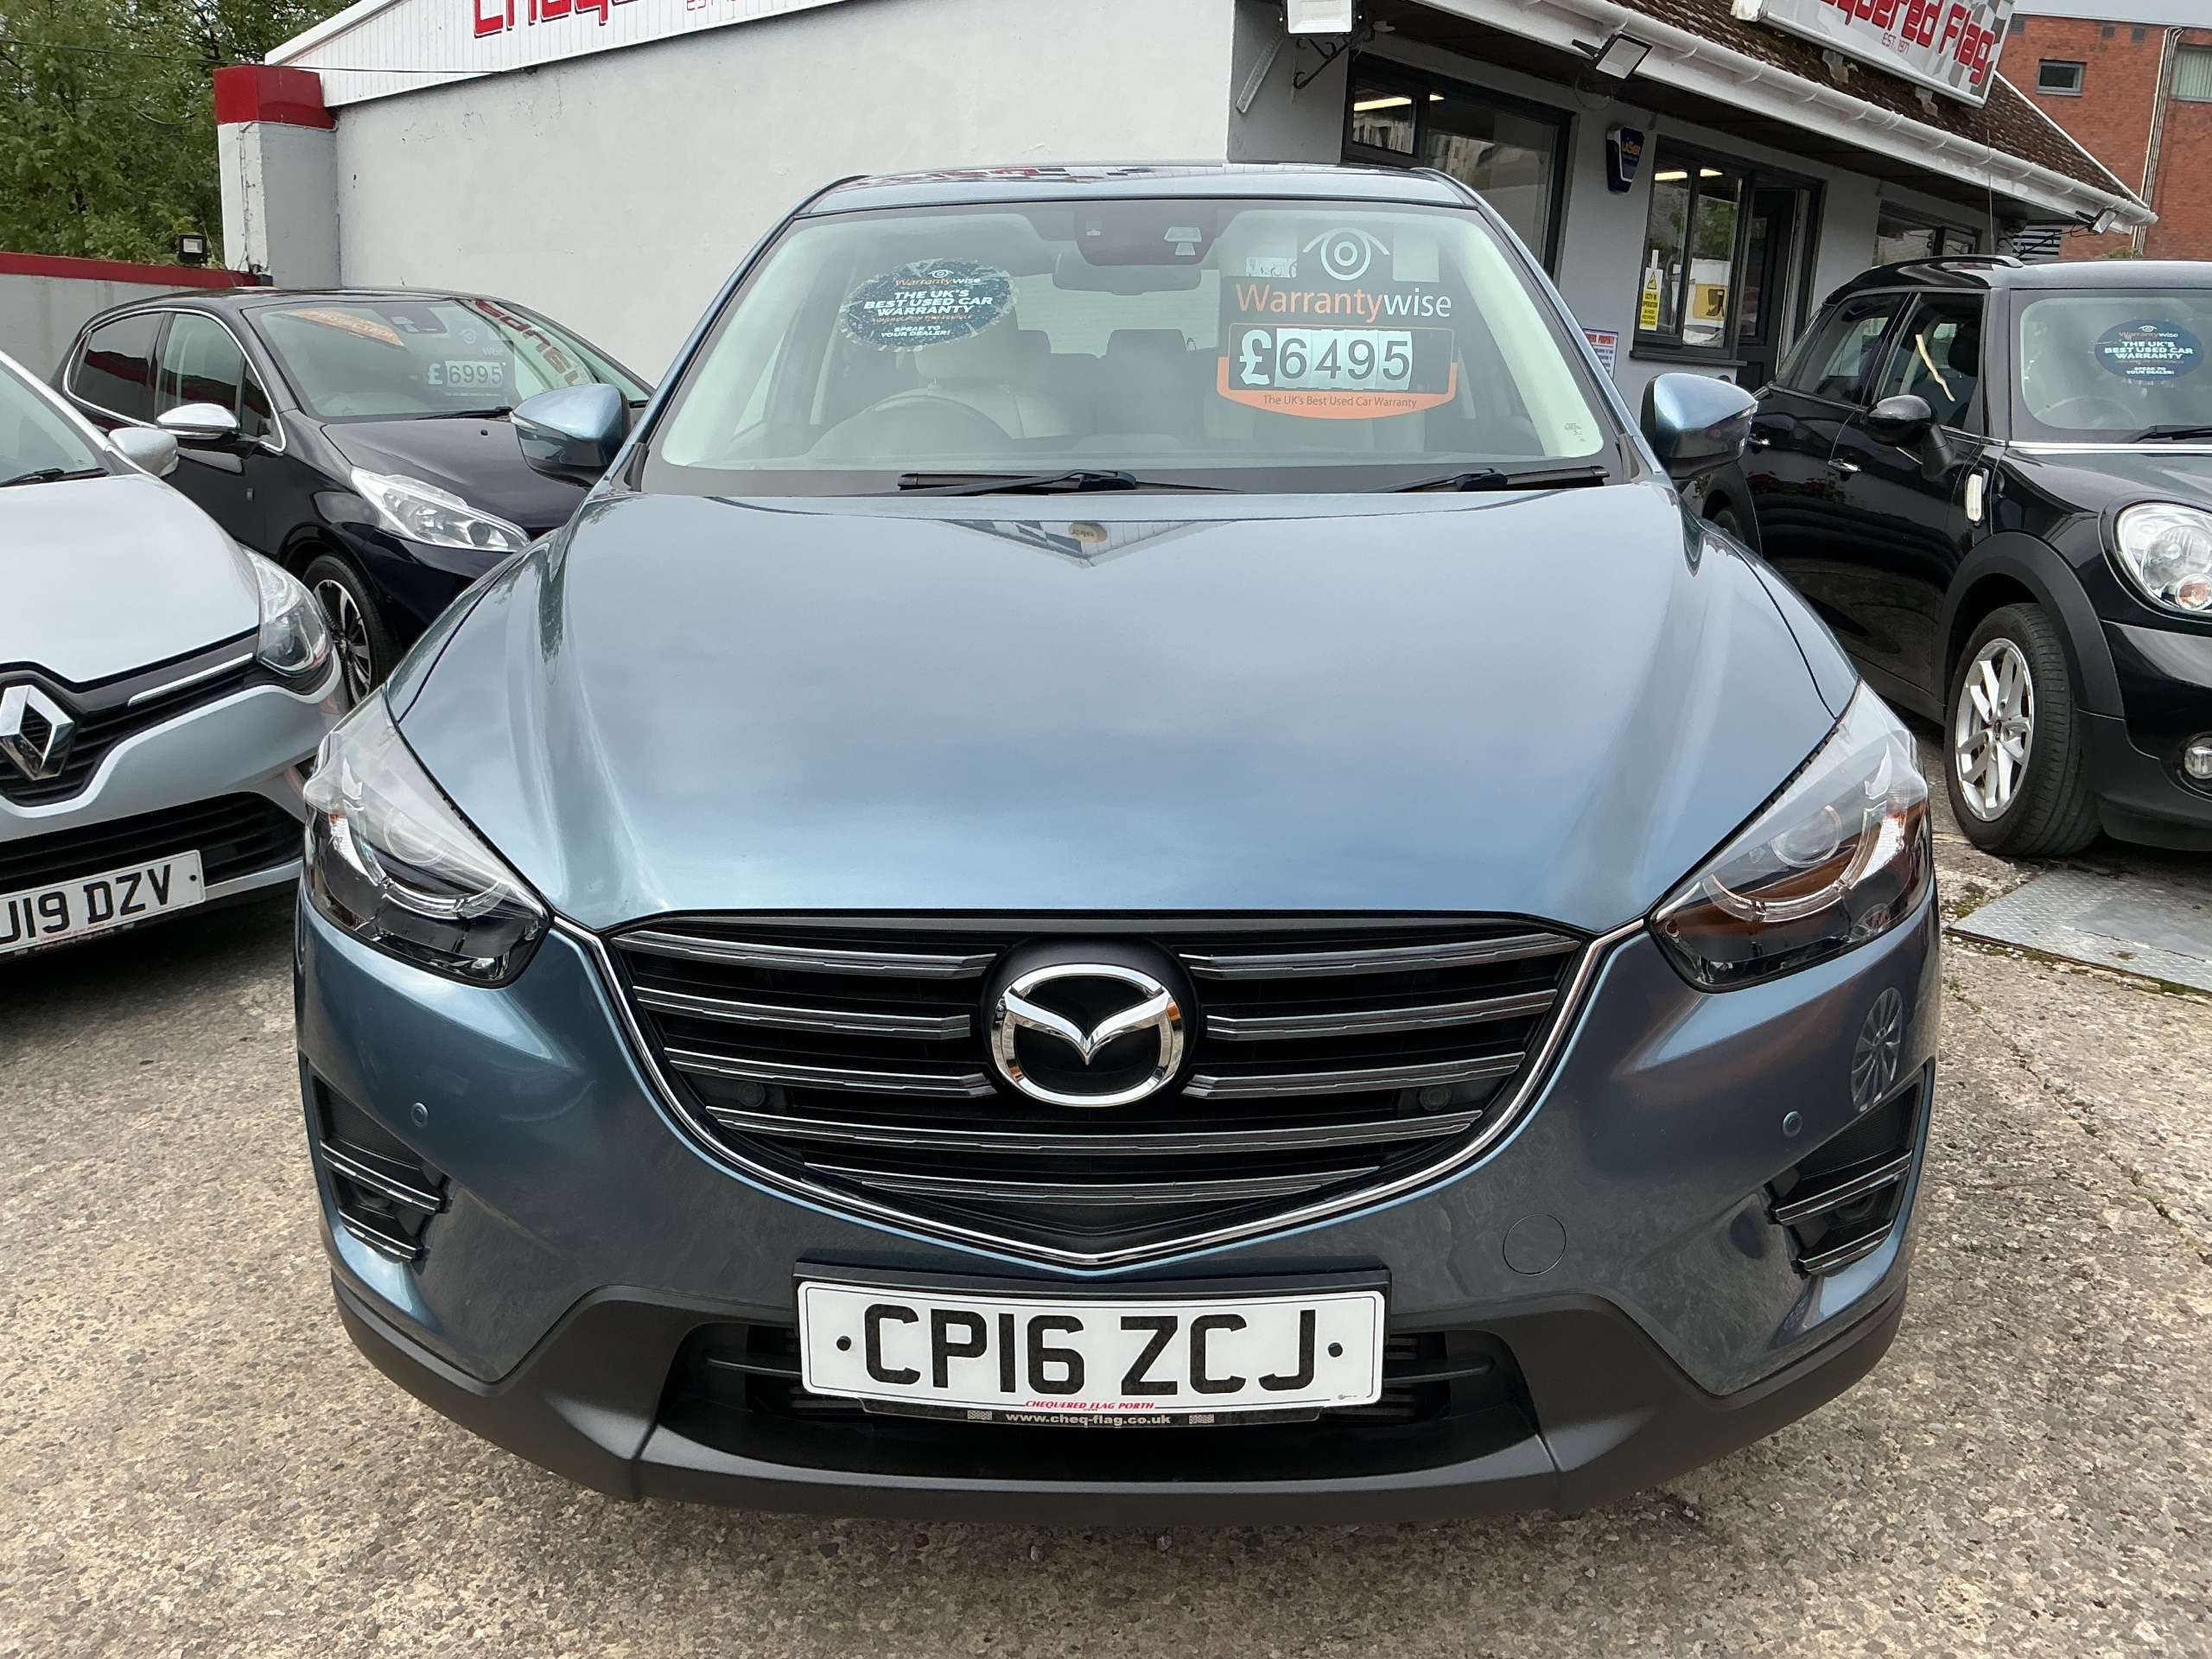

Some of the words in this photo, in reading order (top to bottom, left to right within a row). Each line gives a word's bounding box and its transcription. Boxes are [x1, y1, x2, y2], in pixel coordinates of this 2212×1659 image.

[1939, 3, 1995, 85] Flag
[864, 300, 907, 309] BEST
[910, 298, 955, 307] USED
[894, 291, 927, 300] THE
[931, 289, 969, 298] UK'S
[1236, 283, 1452, 323] Warrantywise
[877, 306, 976, 317] WARRANTY
[1239, 329, 1410, 385] £6495
[429, 363, 502, 385] £6995
[1263, 395, 1282, 404] The
[1284, 395, 1304, 405] UK's
[1306, 396, 1328, 406] Best
[1330, 396, 1353, 406] Used
[1356, 397, 1372, 407] Car
[1374, 397, 1417, 410] Warranty
[83, 864, 172, 925] DZV
[864, 1303, 1086, 1395] CP16
[1121, 1308, 1316, 1396] ZCJ
[1026, 1401, 1087, 1409] CHEQUERED
[1006, 1412, 1171, 1427] www.cheq-flag.co.uk
